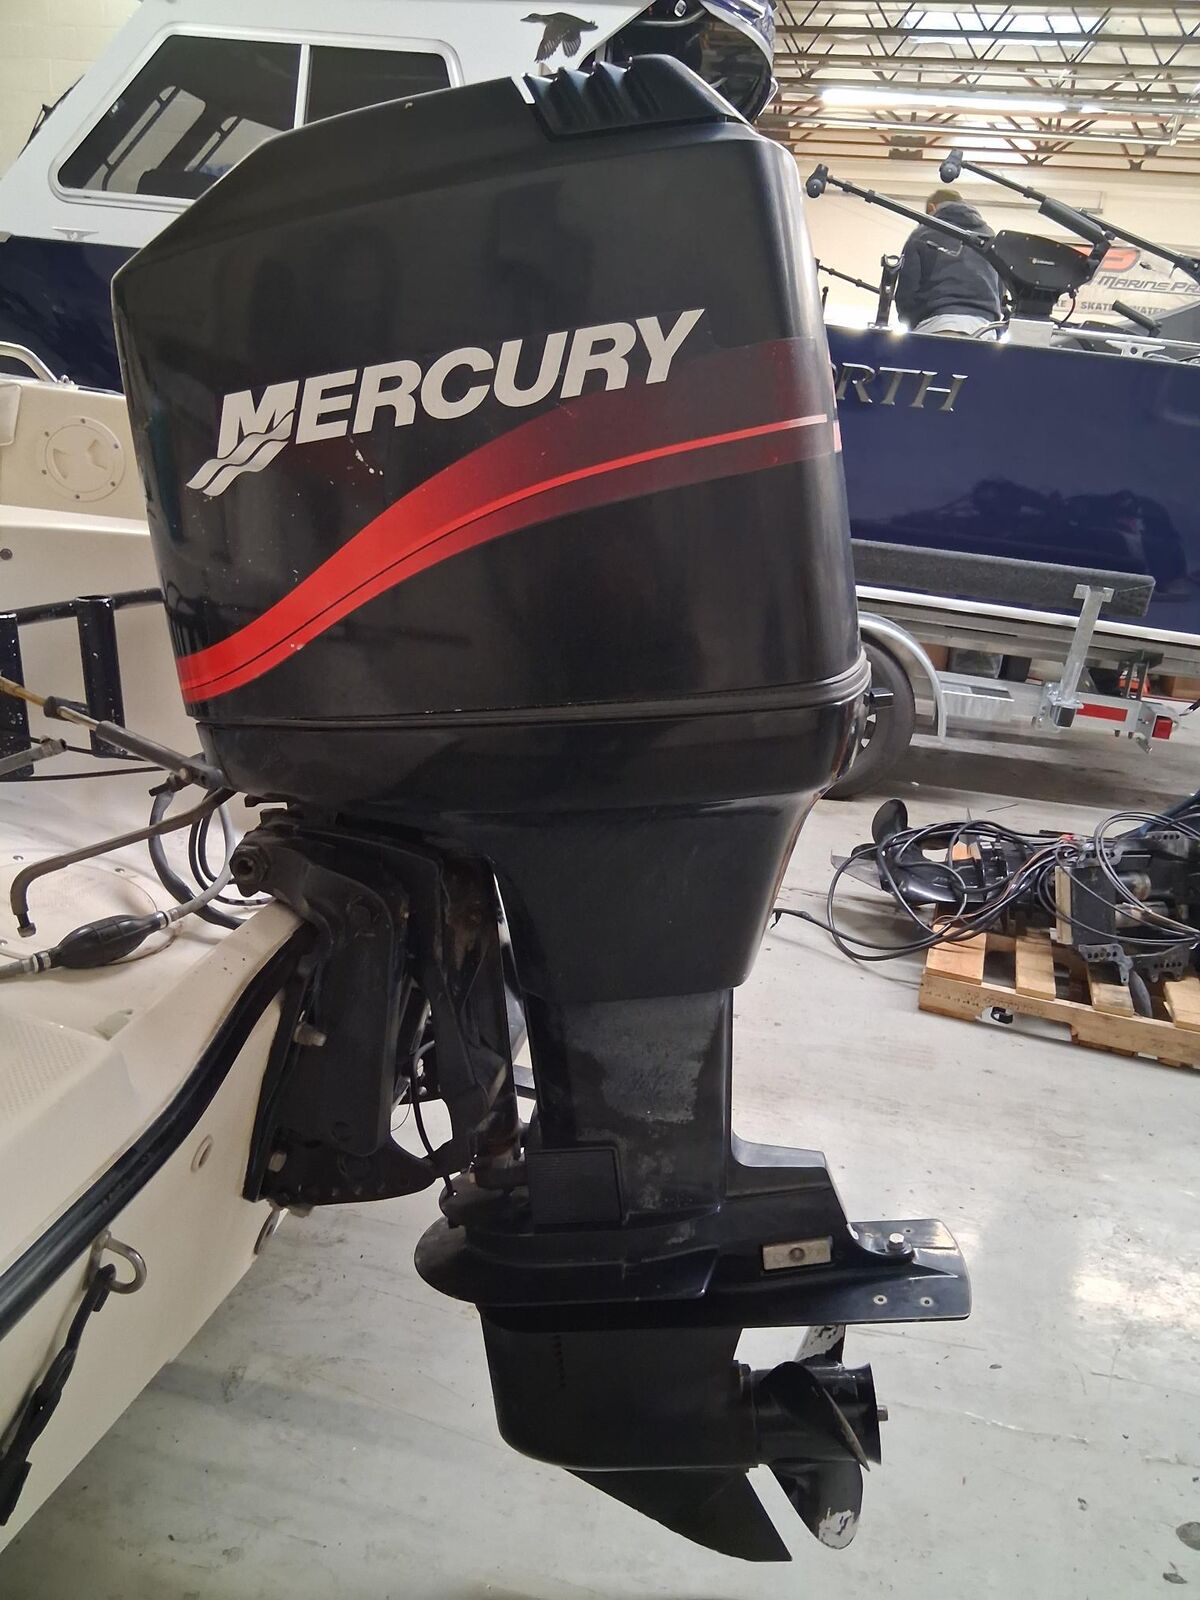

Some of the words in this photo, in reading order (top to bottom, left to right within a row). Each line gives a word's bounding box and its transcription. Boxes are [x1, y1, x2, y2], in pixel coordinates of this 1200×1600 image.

[1170, 281, 1200, 294] PR
[186, 308, 704, 496] MERCURY
[831, 362, 969, 412] RTH
